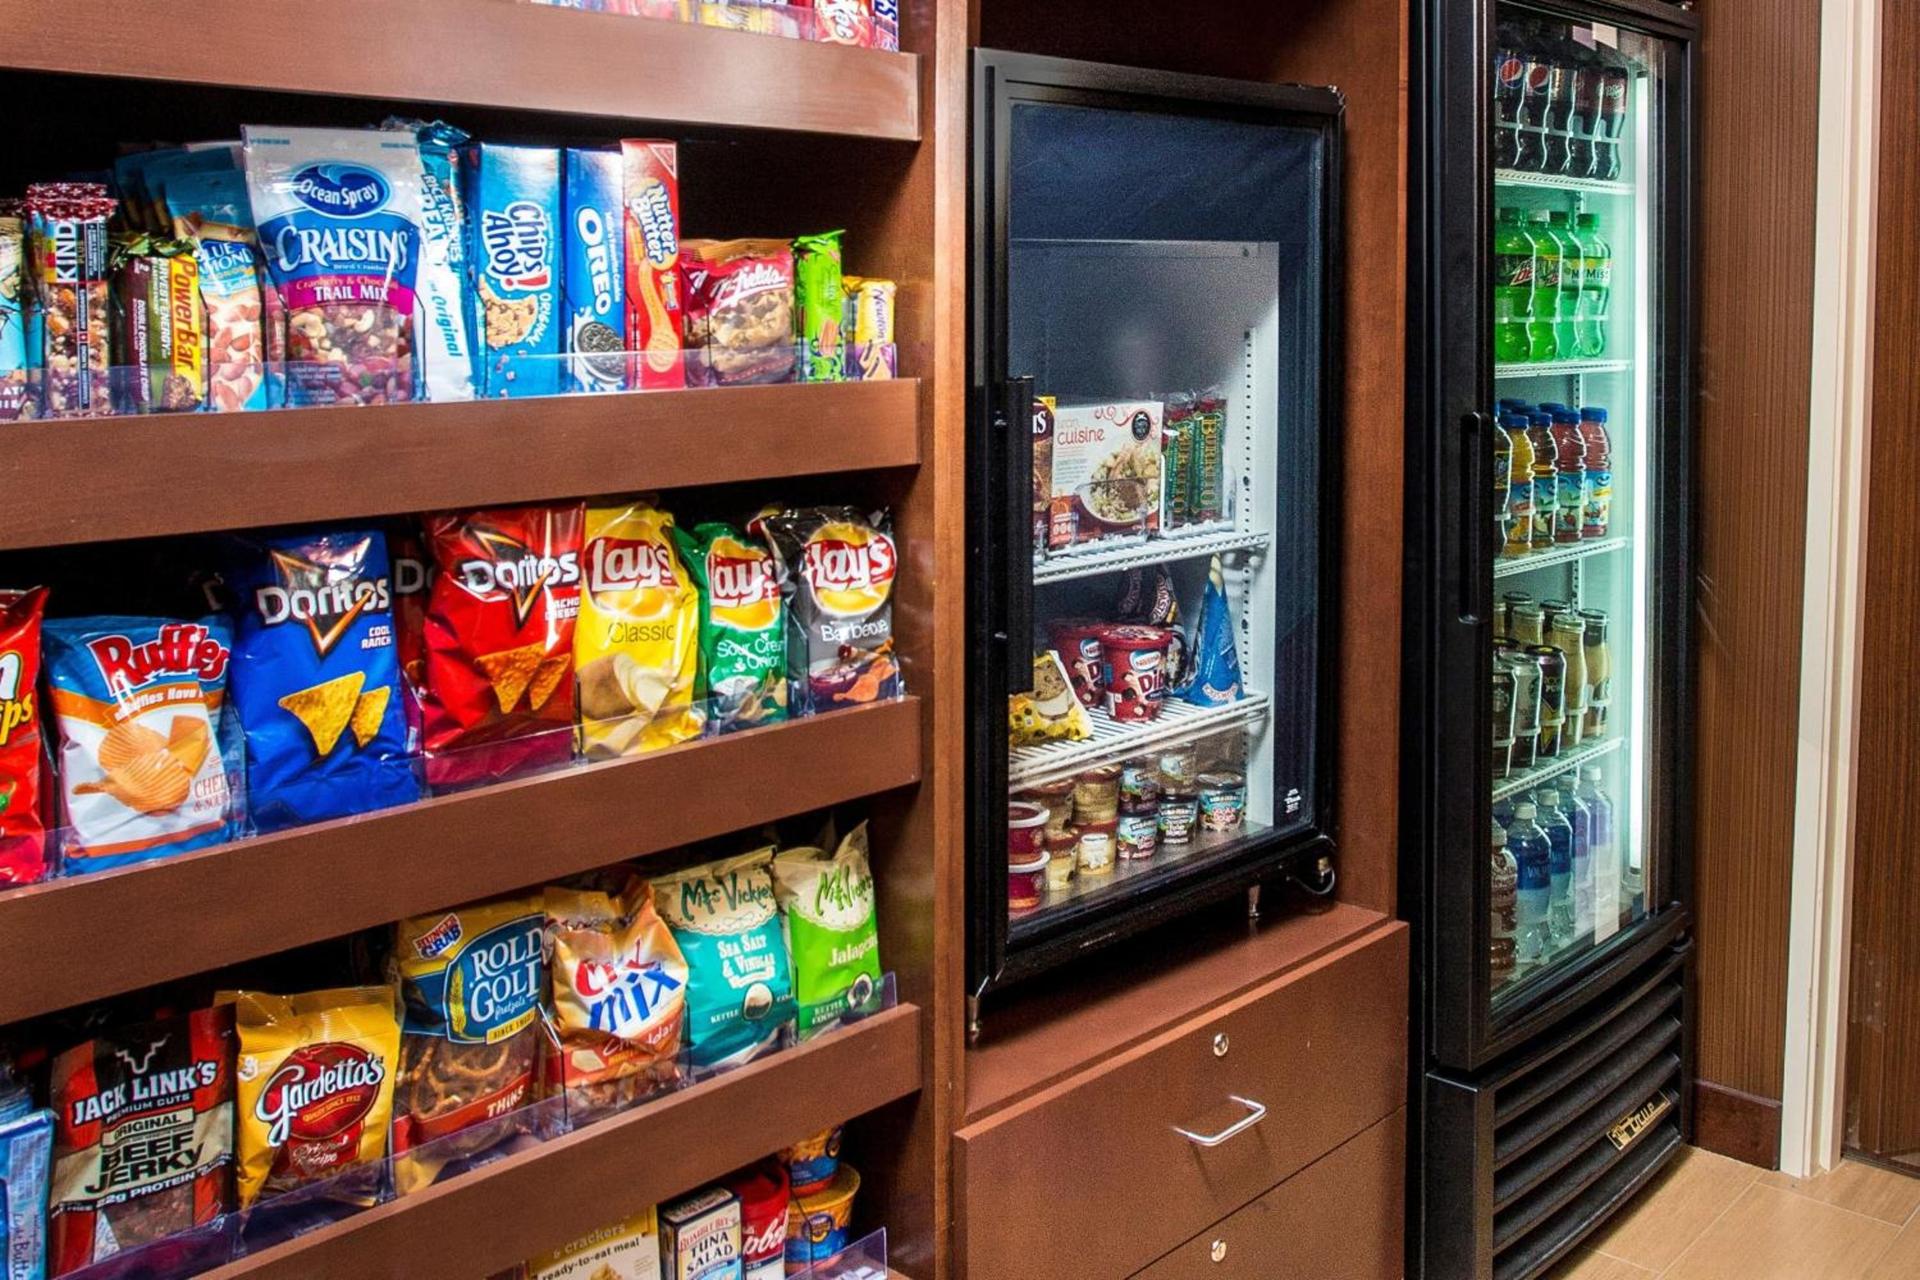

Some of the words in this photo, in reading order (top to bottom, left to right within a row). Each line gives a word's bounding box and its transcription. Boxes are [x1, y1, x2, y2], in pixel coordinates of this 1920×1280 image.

[301, 179, 341, 205] Ocean
[342, 182, 379, 208] Spray
[508, 202, 546, 273] Chips
[630, 196, 664, 263] Butter
[648, 184, 677, 255] Nutter
[55, 222, 77, 284] KIND
[276, 225, 408, 272] CRAISINS
[578, 206, 612, 316] OREO
[172, 253, 199, 371] PowerBar
[314, 286, 355, 302] TRAIL
[432, 294, 463, 357] Original
[1057, 427, 1105, 446] cuisine
[1201, 416, 1218, 506] BURRITO
[462, 552, 580, 594] Doritos
[256, 578, 390, 626] Doritos
[361, 636, 392, 649] RANCH
[368, 626, 391, 638] COOL
[608, 621, 675, 644] Classic
[754, 636, 785, 654] Crea
[1138, 668, 1165, 695] Dib
[471, 927, 543, 981] ROLD
[74, 1082, 126, 1125] JACK
[132, 1061, 217, 1101] LINK'S
[156, 1094, 190, 1107] CUTS
[254, 1053, 386, 1148] Gardetto's
[486, 1084, 525, 1117] THINS
[113, 1113, 182, 1141] ORIGINAL
[84, 1143, 206, 1194] JERKY
[102, 1130, 194, 1173] BEEF
[130, 1172, 196, 1199] PROTEIN
[564, 1223, 626, 1254] crackers
[613, 1236, 641, 1253] meal
[691, 1231, 730, 1258] TUNA
[687, 1243, 734, 1273] SALAD
